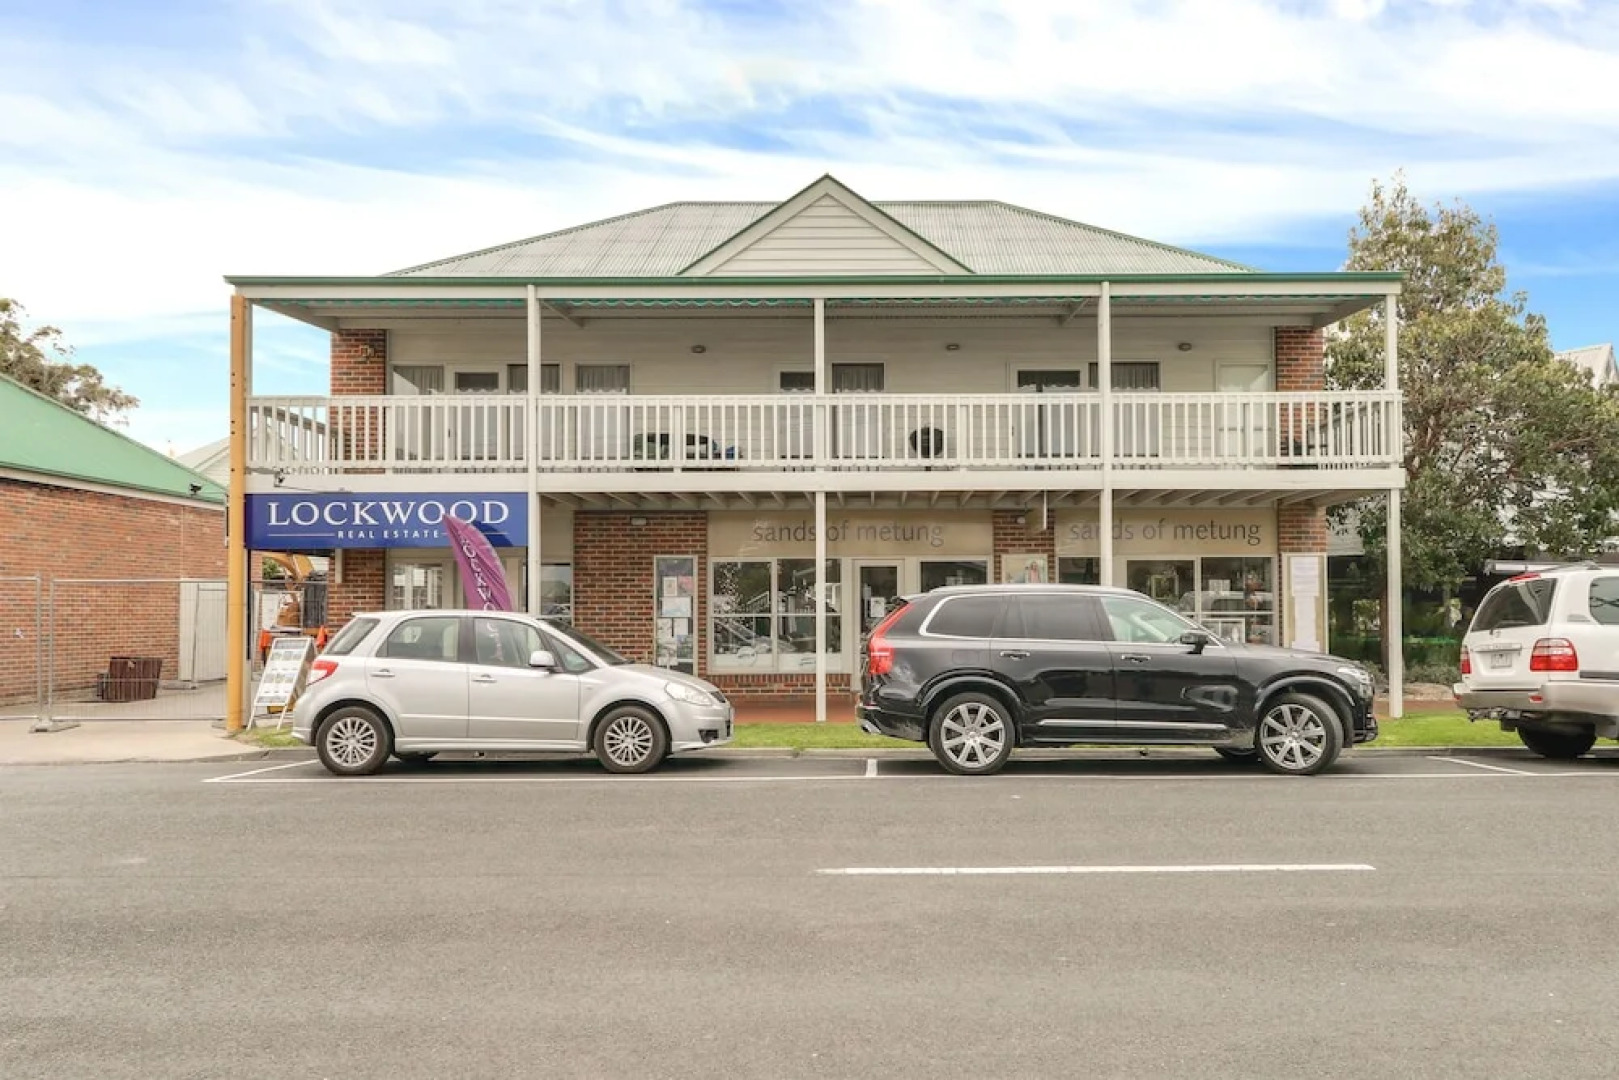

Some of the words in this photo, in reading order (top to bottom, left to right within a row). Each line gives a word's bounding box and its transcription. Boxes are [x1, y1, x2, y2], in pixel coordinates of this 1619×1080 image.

[267, 501, 510, 526] LOCKWOOD
[337, 530, 375, 539] REAL
[383, 530, 440, 539] ESTATE
[752, 520, 817, 542] sands
[826, 519, 850, 542] of
[857, 521, 945, 548] metung
[1142, 518, 1166, 540] of
[1173, 519, 1262, 546] metung
